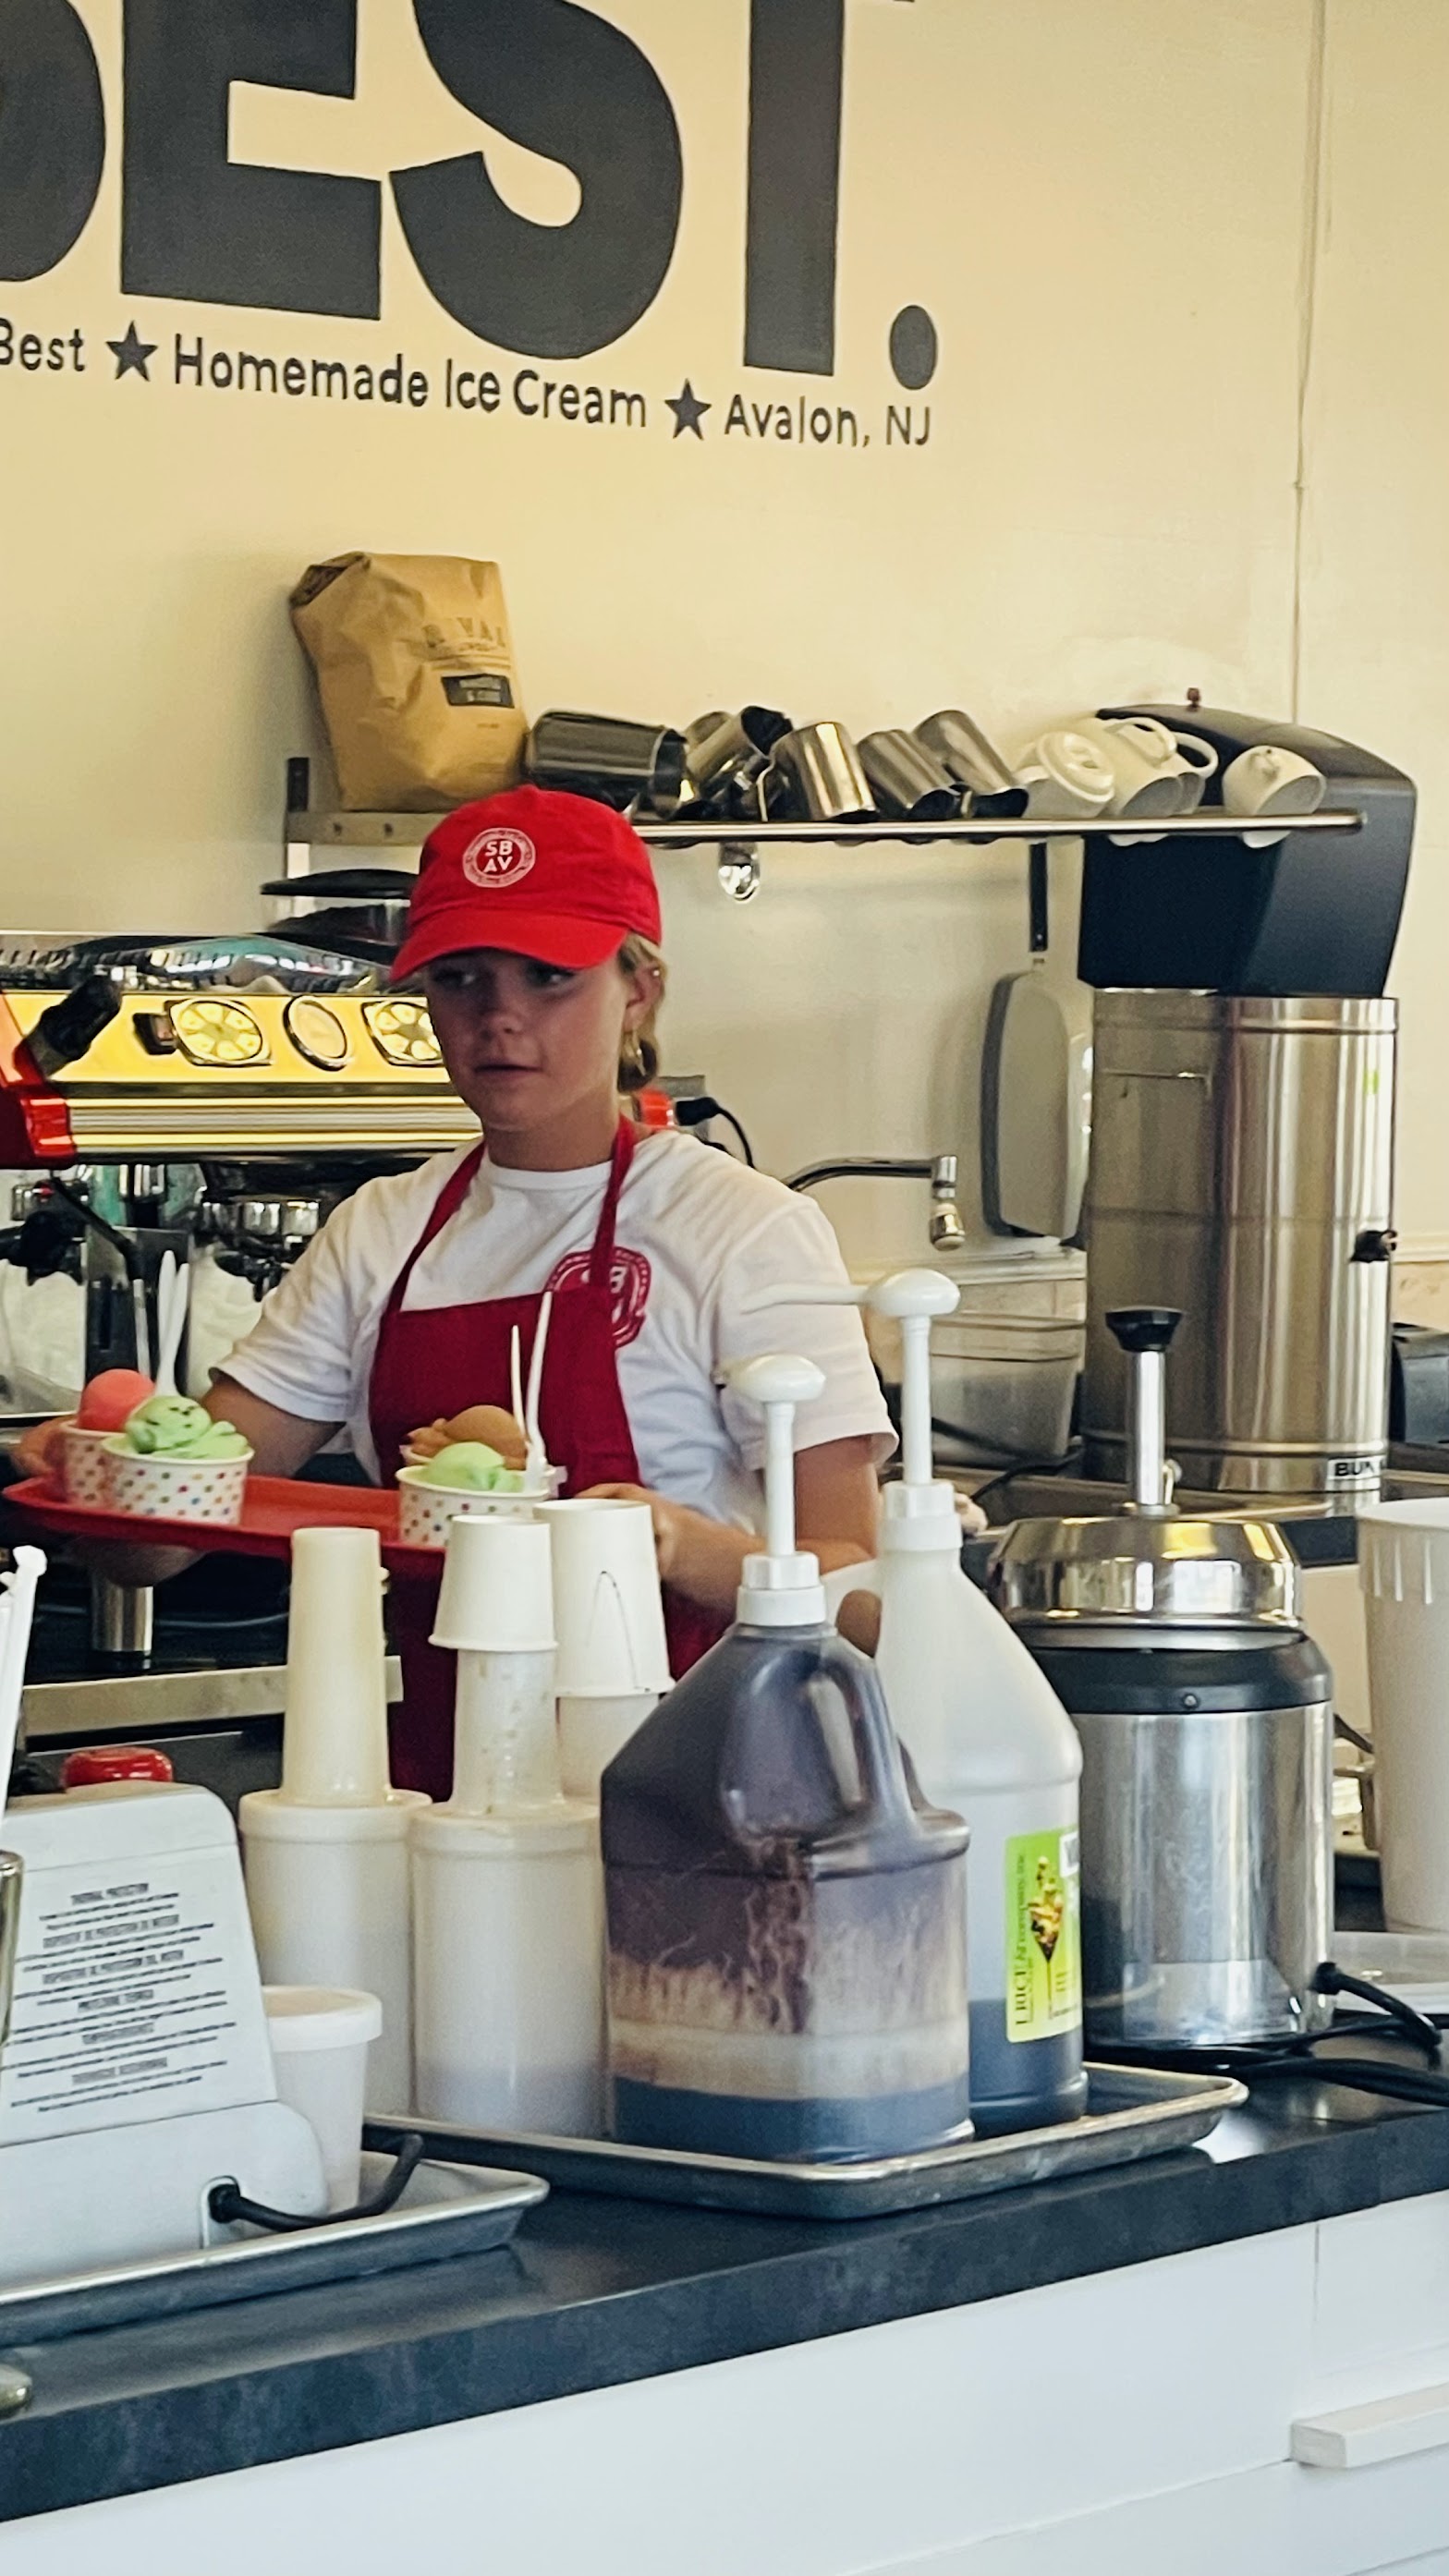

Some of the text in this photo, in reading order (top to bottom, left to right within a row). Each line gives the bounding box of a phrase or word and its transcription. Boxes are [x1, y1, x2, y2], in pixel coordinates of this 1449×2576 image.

[0, 0, 938, 391] EST.
[0, 317, 932, 448] Best Homemade Ice Cream Avalon, NJ
[483, 856, 513, 872] AV
[485, 840, 513, 857] SB
